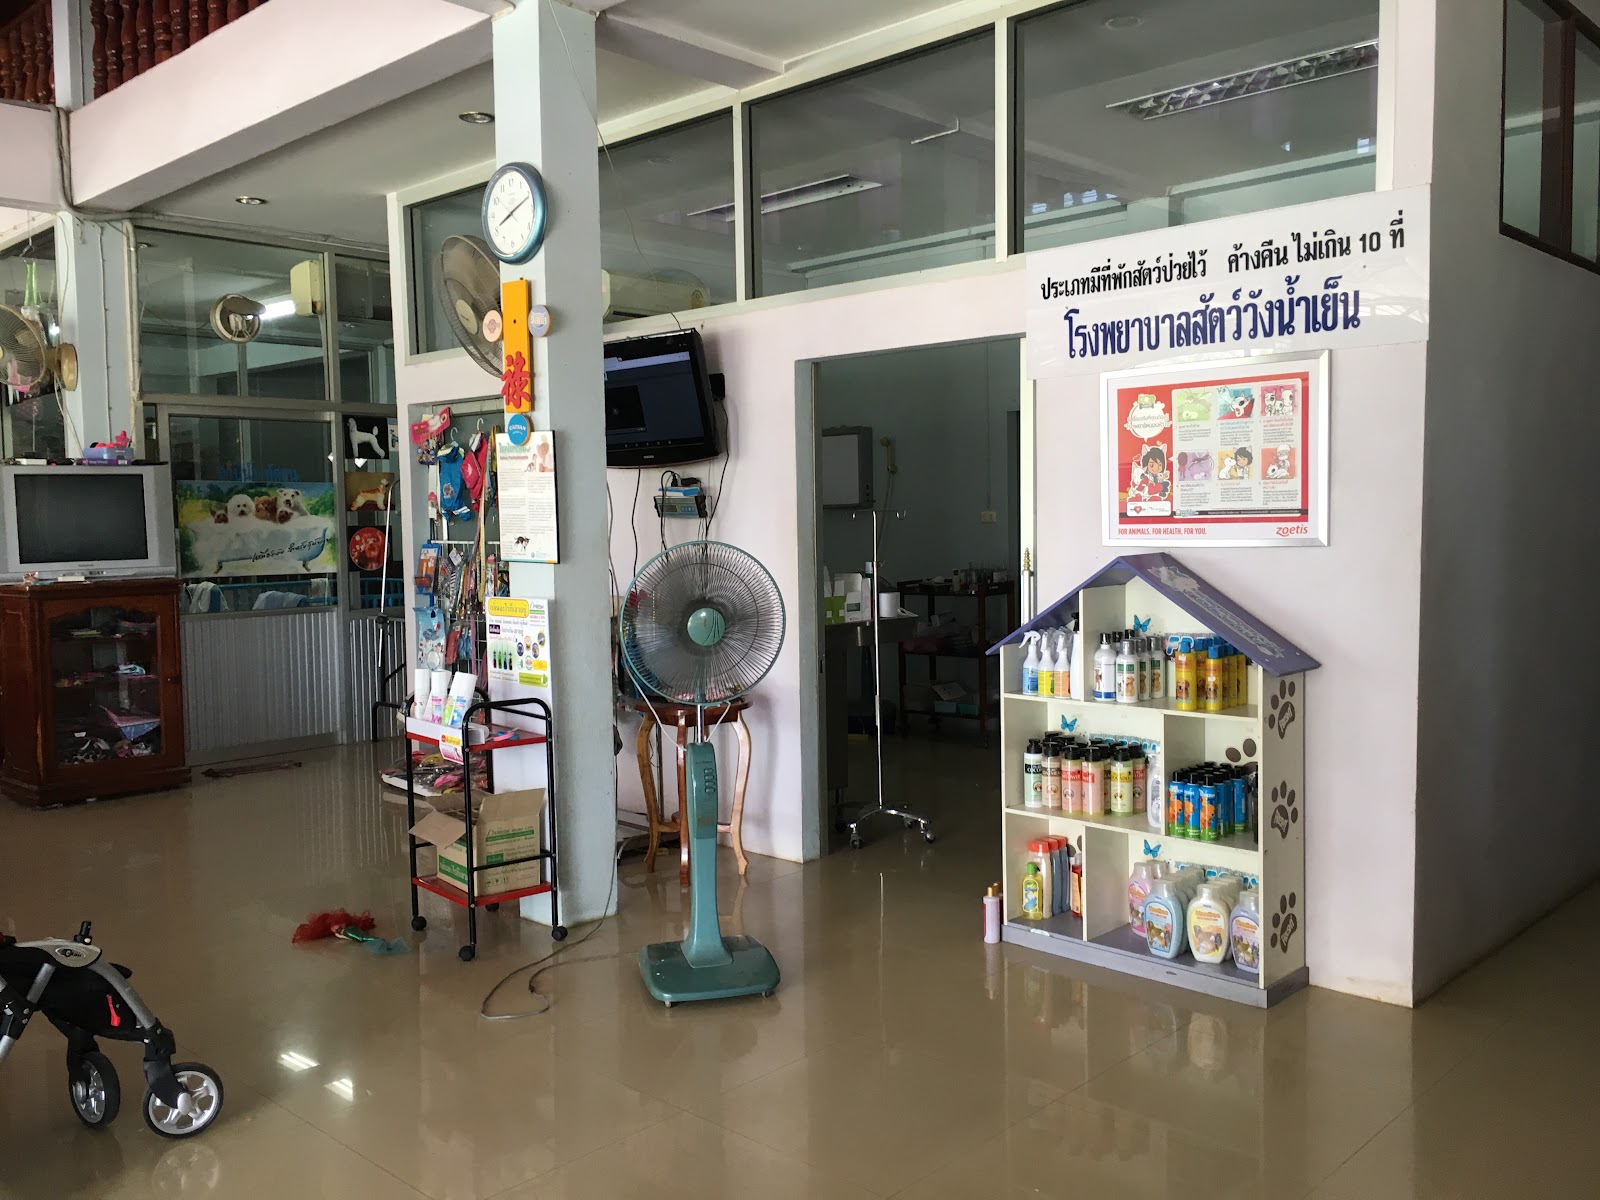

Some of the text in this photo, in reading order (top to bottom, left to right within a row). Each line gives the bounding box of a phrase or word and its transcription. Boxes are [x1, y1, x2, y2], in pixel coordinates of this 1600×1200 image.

[1227, 239, 1289, 273] ค้างคืน
[1291, 229, 1351, 263] ไม่เกิน
[1359, 231, 1381, 253] 10
[1389, 209, 1405, 249] ที่
[1064, 275, 1361, 359] โรงพยาบาลสัตว์วังน้ำเย็น
[1194, 527, 1207, 535] YOU.
[1276, 524, 1308, 537] zoetis
